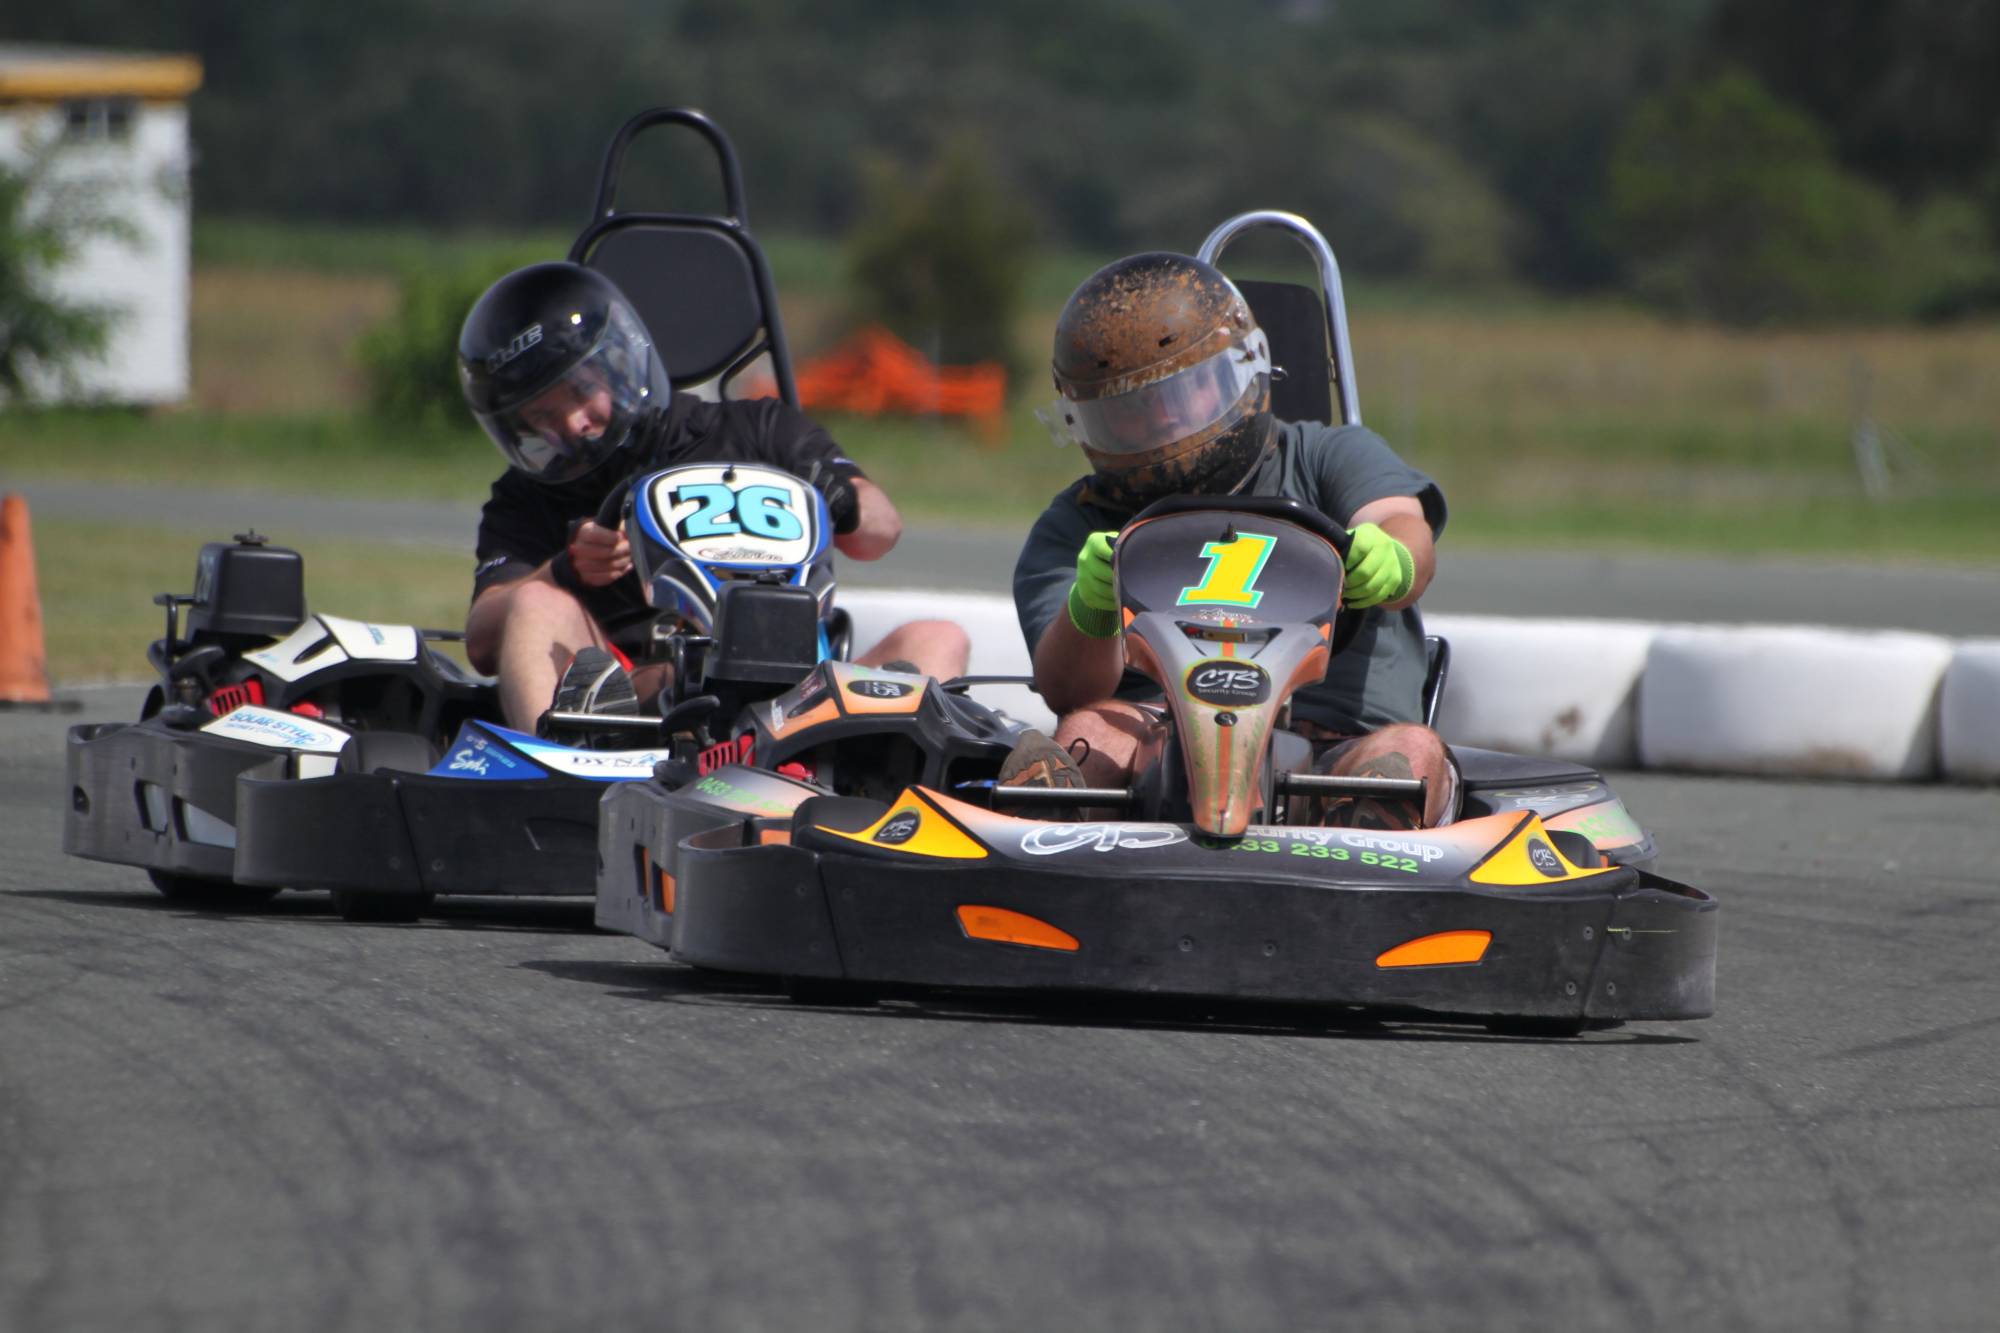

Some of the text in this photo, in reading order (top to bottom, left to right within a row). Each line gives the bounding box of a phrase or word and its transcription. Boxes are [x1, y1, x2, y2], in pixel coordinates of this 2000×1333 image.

[668, 483, 804, 542] 26
[1176, 531, 1278, 609] 1
[1195, 668, 1260, 690] CTS
[1198, 687, 1257, 698] Security Group
[1246, 827, 1334, 846] curity
[1340, 831, 1444, 862] Group
[1290, 843, 1350, 861] 233
[1360, 851, 1419, 873] 522
